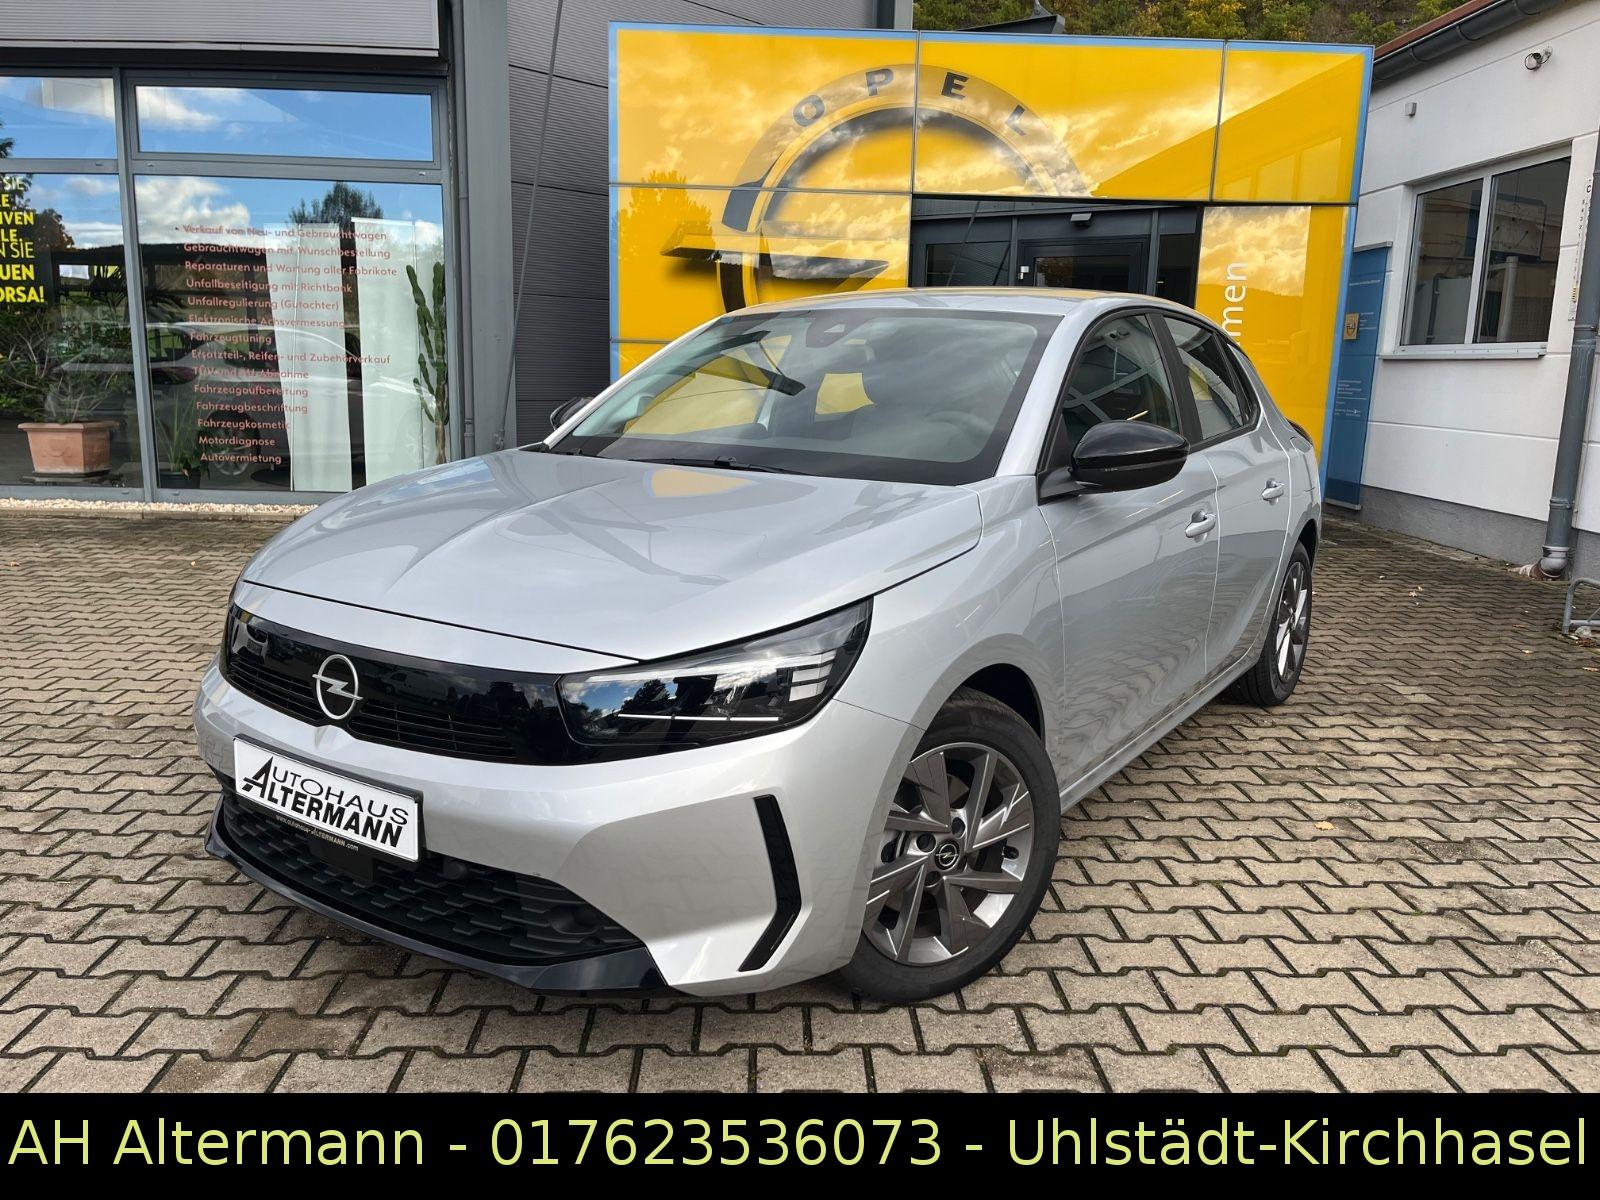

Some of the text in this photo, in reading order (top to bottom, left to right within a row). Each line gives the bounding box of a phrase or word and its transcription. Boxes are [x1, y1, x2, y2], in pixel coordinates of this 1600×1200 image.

[792, 68, 1027, 137] OPEL
[0, 194, 10, 207] E
[183, 225, 224, 234] Verkauf
[275, 228, 294, 237] und
[298, 229, 387, 241] Gebrauchtwagen
[10, 242, 35, 259] SIE
[184, 244, 274, 256] Gebrauchtwagen
[298, 247, 391, 260] Wunschbestellung
[185, 261, 397, 276] Reparaturen und Wartung aller Fabrikate
[186, 279, 278, 292] Unfallbeseitigung
[301, 283, 352, 293] Richtbank
[187, 297, 339, 311] Unfallregulierung (Gutachter)
[1221, 262, 1248, 338] men
[188, 314, 345, 328] Elektronische Achsvermessung
[190, 333, 272, 345] Fahrzeugtuning
[249, 351, 284, 361] Reifen-
[288, 353, 307, 362] und
[194, 385, 309, 398] Fahrzeugaufbereitung
[196, 402, 308, 414] Fahrzeugbeschriftung
[198, 419, 291, 431] Fahrzeugkosmetik
[199, 436, 276, 448] Motordiagnose
[201, 453, 282, 464] Autovermietung
[243, 757, 409, 826] AUTOHAUS
[243, 757, 403, 848] ALTERMANN
